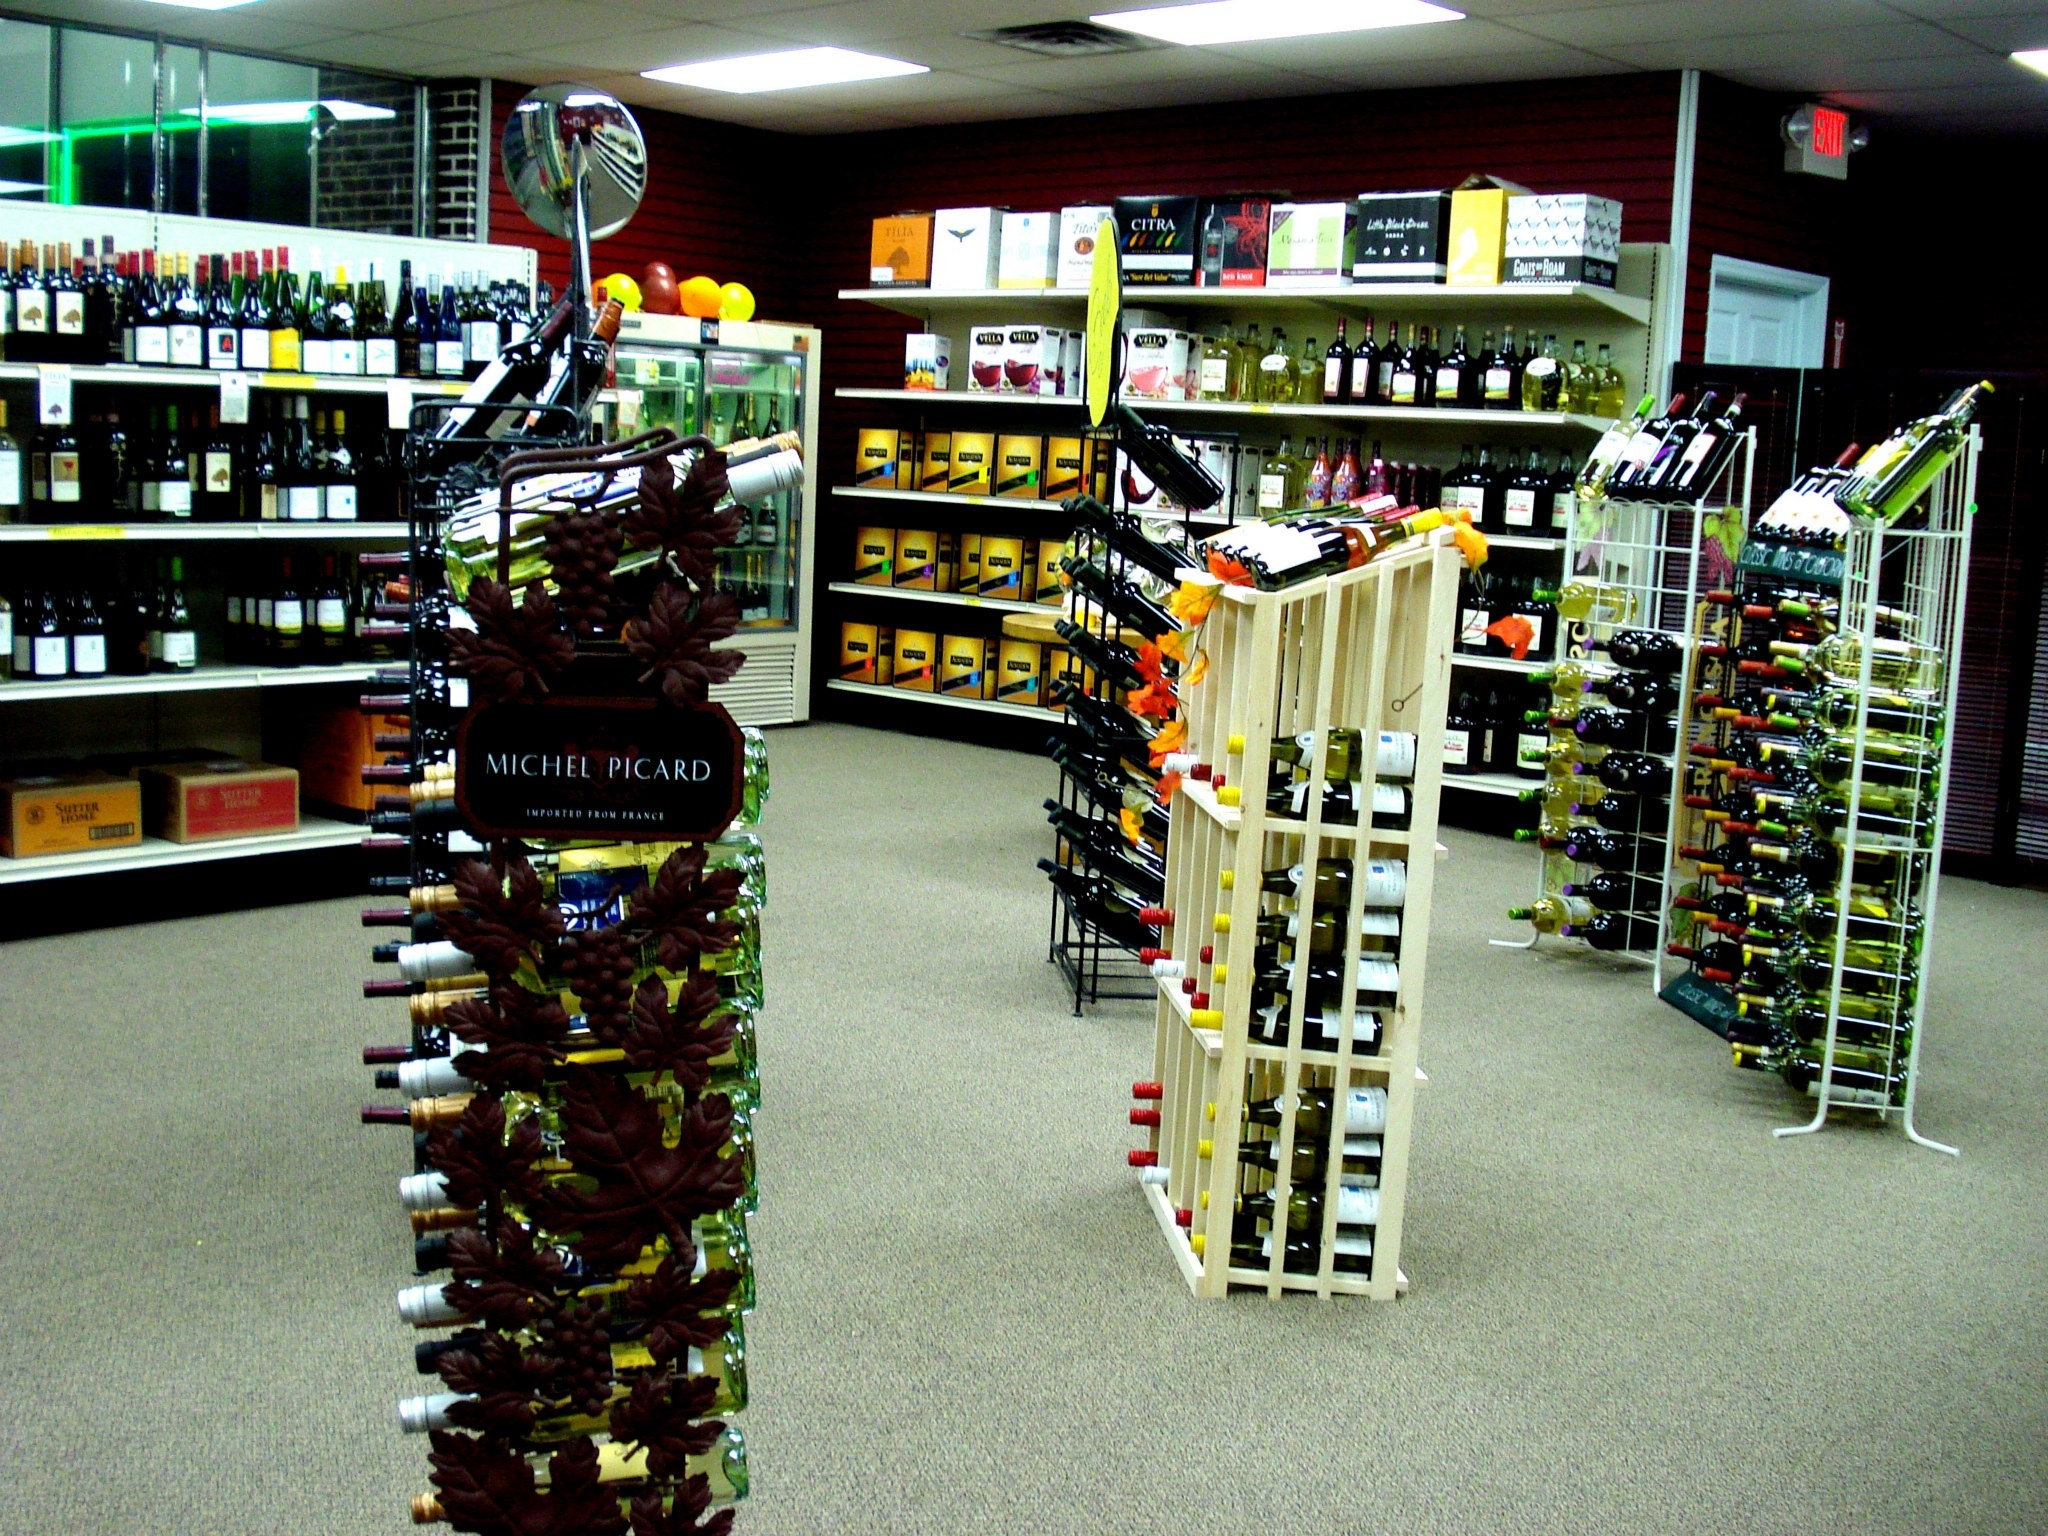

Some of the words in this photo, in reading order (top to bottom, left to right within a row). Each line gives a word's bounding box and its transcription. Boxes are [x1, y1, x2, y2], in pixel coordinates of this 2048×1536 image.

[1814, 107, 1846, 157] EXIT
[1131, 218, 1176, 231] CITRA
[1542, 258, 1566, 277] ROAM
[979, 333, 1002, 344] VELLA
[1011, 332, 1036, 342] VELLA
[1138, 334, 1164, 345] VELLA
[486, 752, 591, 778] MICHEL
[608, 755, 711, 782] PICARD
[55, 801, 99, 813] SUTTER
[60, 812, 96, 825] HOME
[526, 808, 582, 819] IMPORTED
[588, 809, 617, 820] FROM
[622, 810, 665, 821] FRANCE
